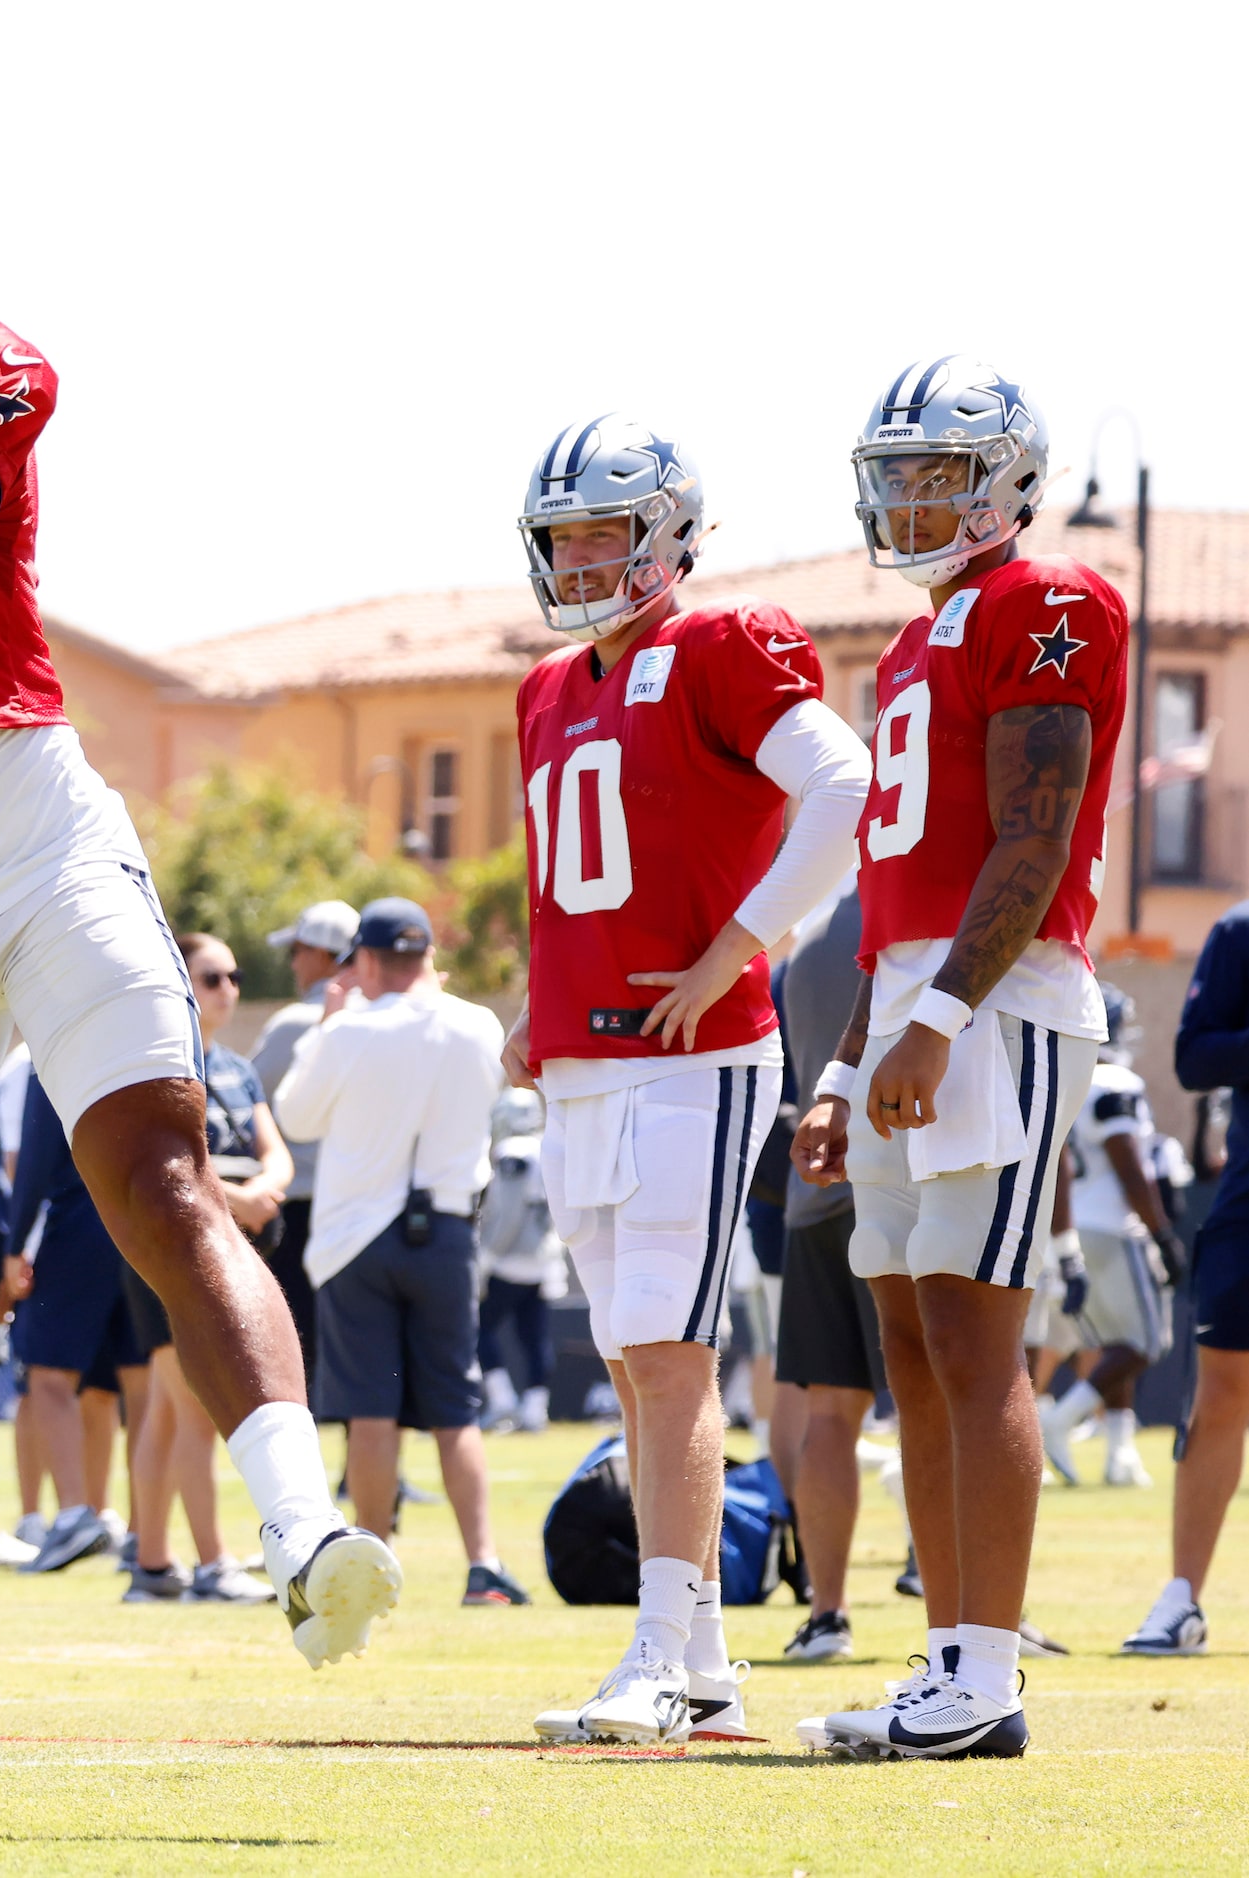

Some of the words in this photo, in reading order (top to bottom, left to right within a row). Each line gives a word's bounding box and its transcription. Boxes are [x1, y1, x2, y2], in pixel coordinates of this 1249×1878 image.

[878, 429, 914, 439] COWBOYS
[540, 497, 574, 510] COWBOYS
[934, 625, 956, 638] AT&T
[527, 738, 634, 915] 10
